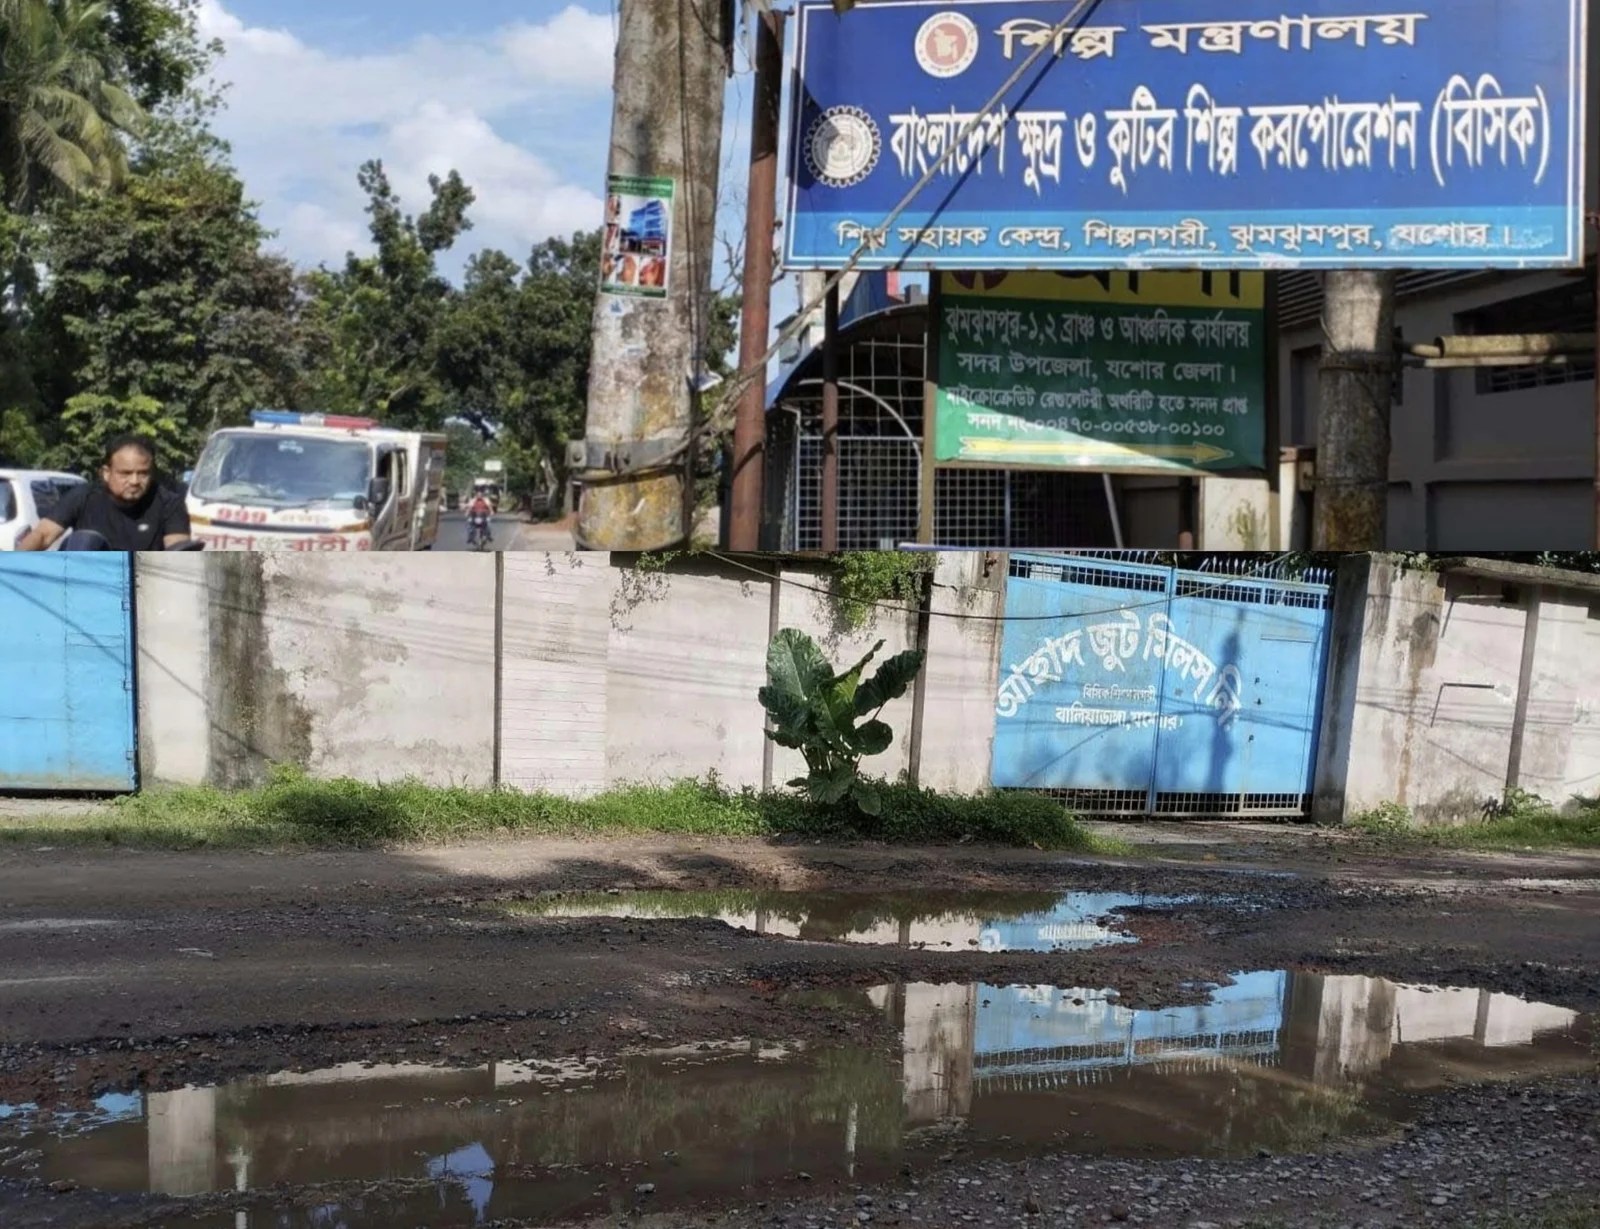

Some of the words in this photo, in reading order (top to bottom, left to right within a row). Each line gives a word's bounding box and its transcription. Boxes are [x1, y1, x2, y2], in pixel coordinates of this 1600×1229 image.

[994, 18, 1126, 60] শিল্প
[1141, 13, 1429, 55] মন্ত্রণালয়
[889, 105, 1008, 178] বাংলাদেশ
[1015, 109, 1068, 196] ক্ষুদ্র
[1074, 112, 1097, 168] ও
[1105, 84, 1178, 196] কুটির
[1184, 83, 1243, 176] শিল্প
[1248, 93, 1422, 172] করপোরেশন
[1430, 73, 1550, 187] (বিসিক)
[898, 225, 989, 250] সহায়ক
[999, 225, 1071, 252] কেন্দ্র,
[1082, 218, 1218, 252] শিল্পনগরী,
[1230, 222, 1382, 252] ঝুমঝুমপুর,
[1100, 316, 1115, 341] ও
[1189, 310, 1252, 349] কার্যালয়
[956, 352, 1003, 374] সদর
[1008, 350, 1098, 384] উপজেলা,
[1104, 359, 1167, 381] যশোর
[1173, 361, 1224, 383] জেলা
[966, 412, 1003, 431] সনদ
[1157, 395, 1187, 415] হতে
[1188, 396, 1220, 415] সনদ
[1086, 604, 1142, 673] জুট
